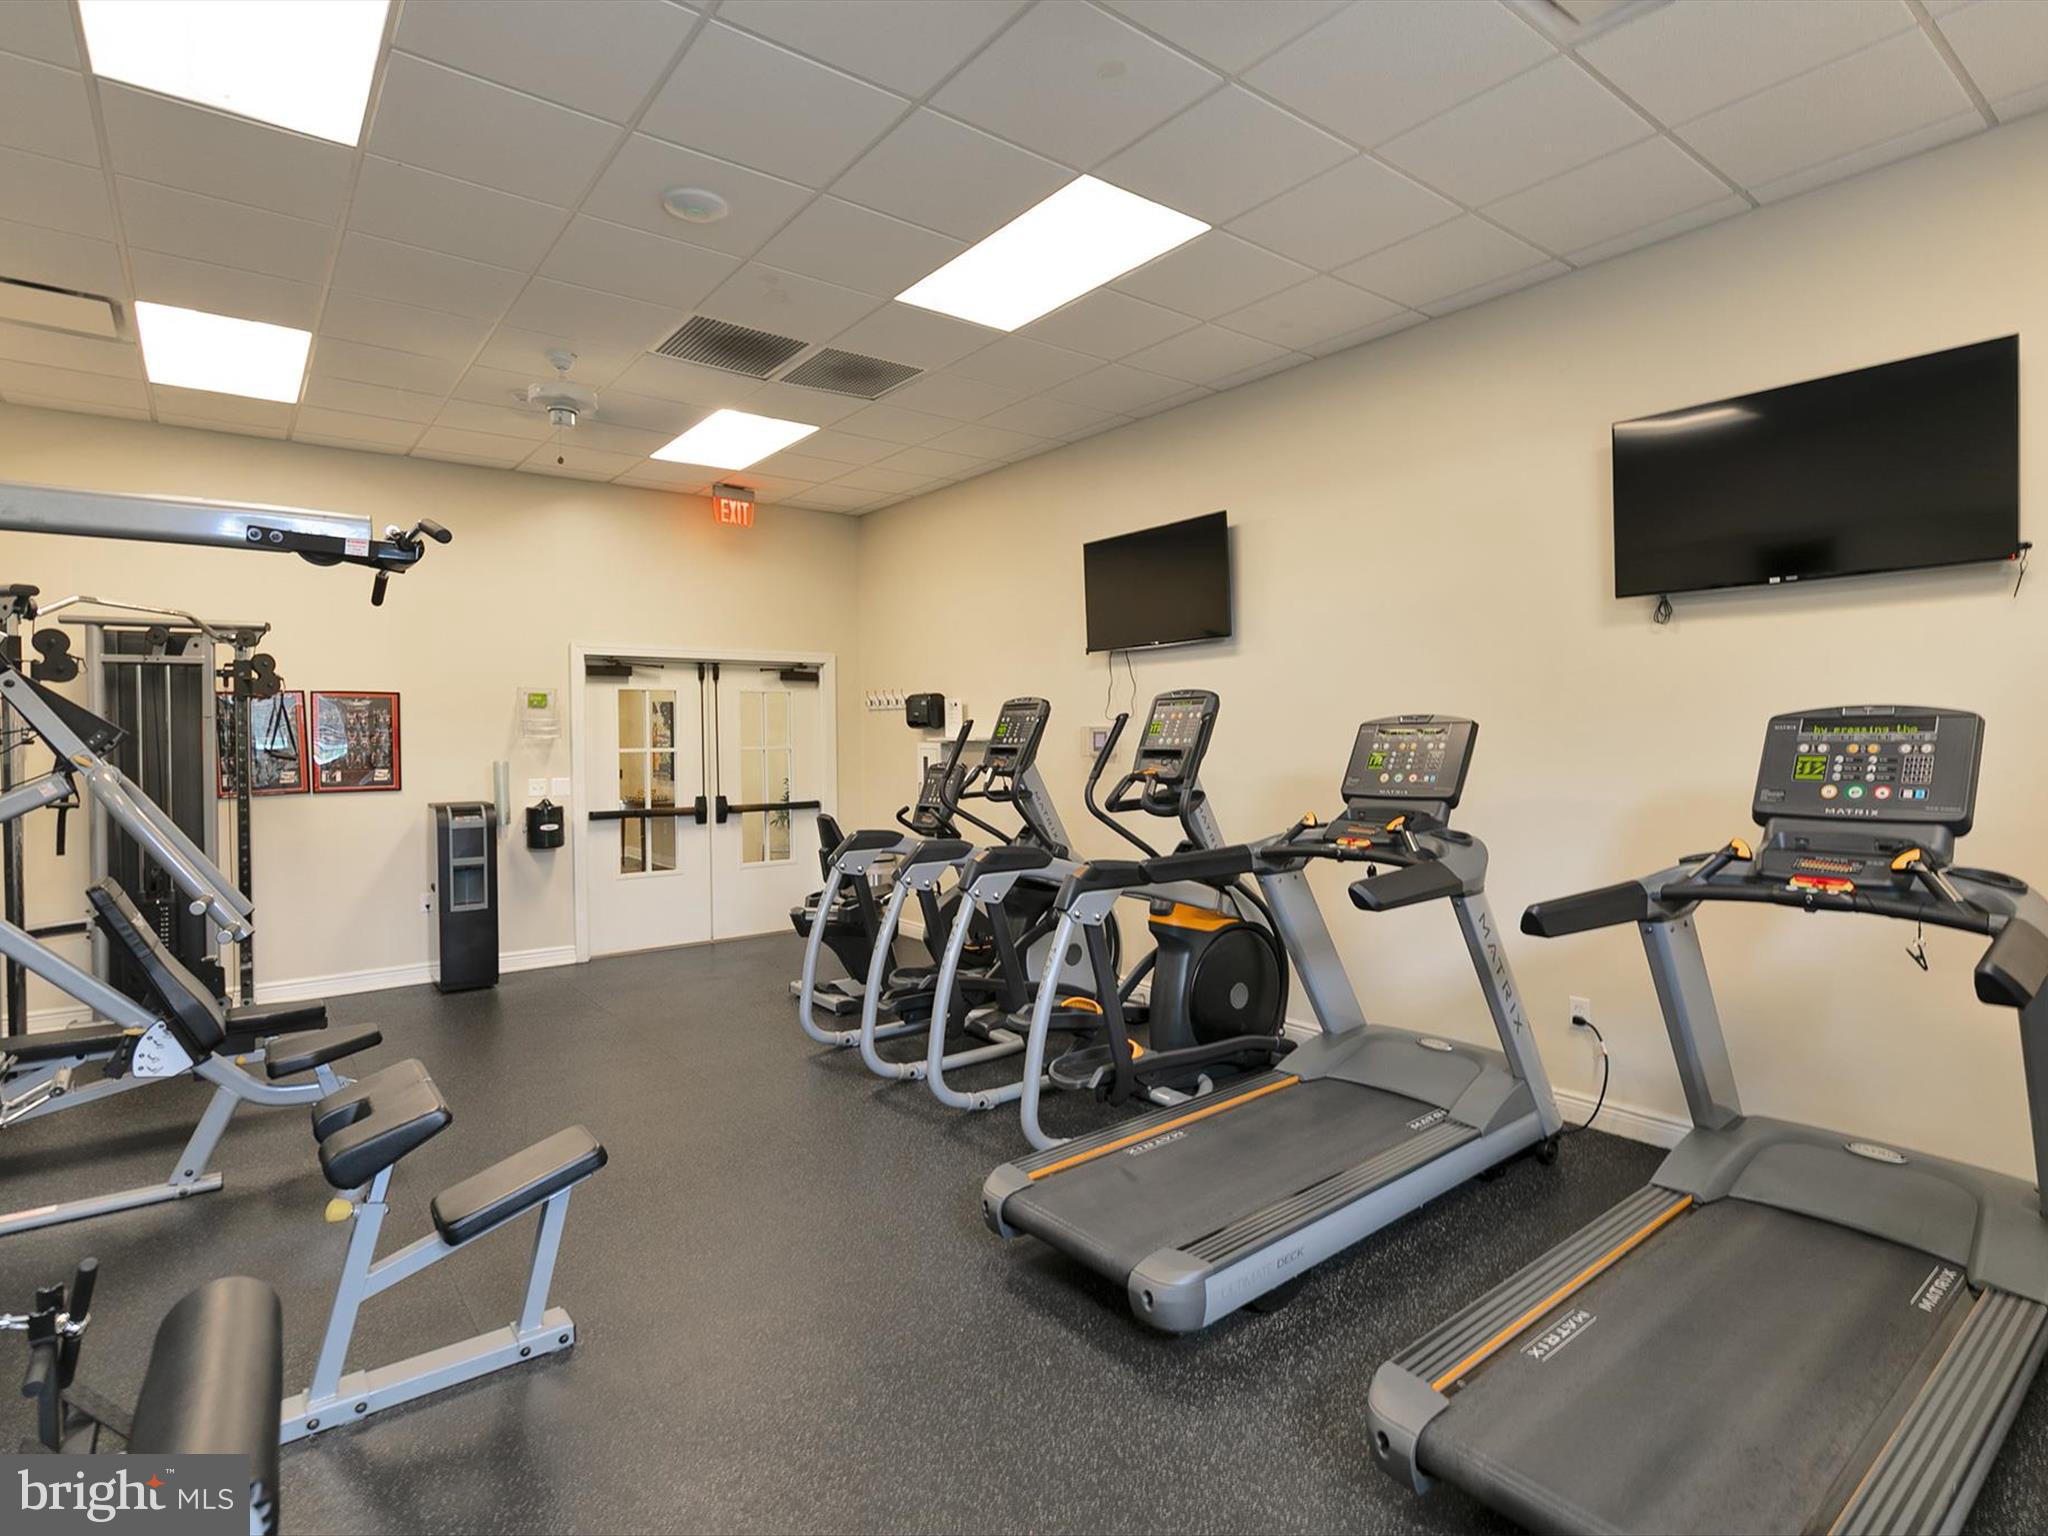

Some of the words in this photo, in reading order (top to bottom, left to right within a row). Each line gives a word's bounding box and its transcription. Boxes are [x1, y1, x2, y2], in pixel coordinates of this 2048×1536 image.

[720, 498, 749, 525] EXIT
[1896, 723, 1919, 734] the
[1825, 807, 1879, 817] MATRIX
[1478, 912, 1523, 1034] MATRIX
[1277, 1247, 1304, 1269] DECK
[1918, 1268, 1957, 1312] MATRIX
[1527, 1310, 1591, 1359] MATRIX
